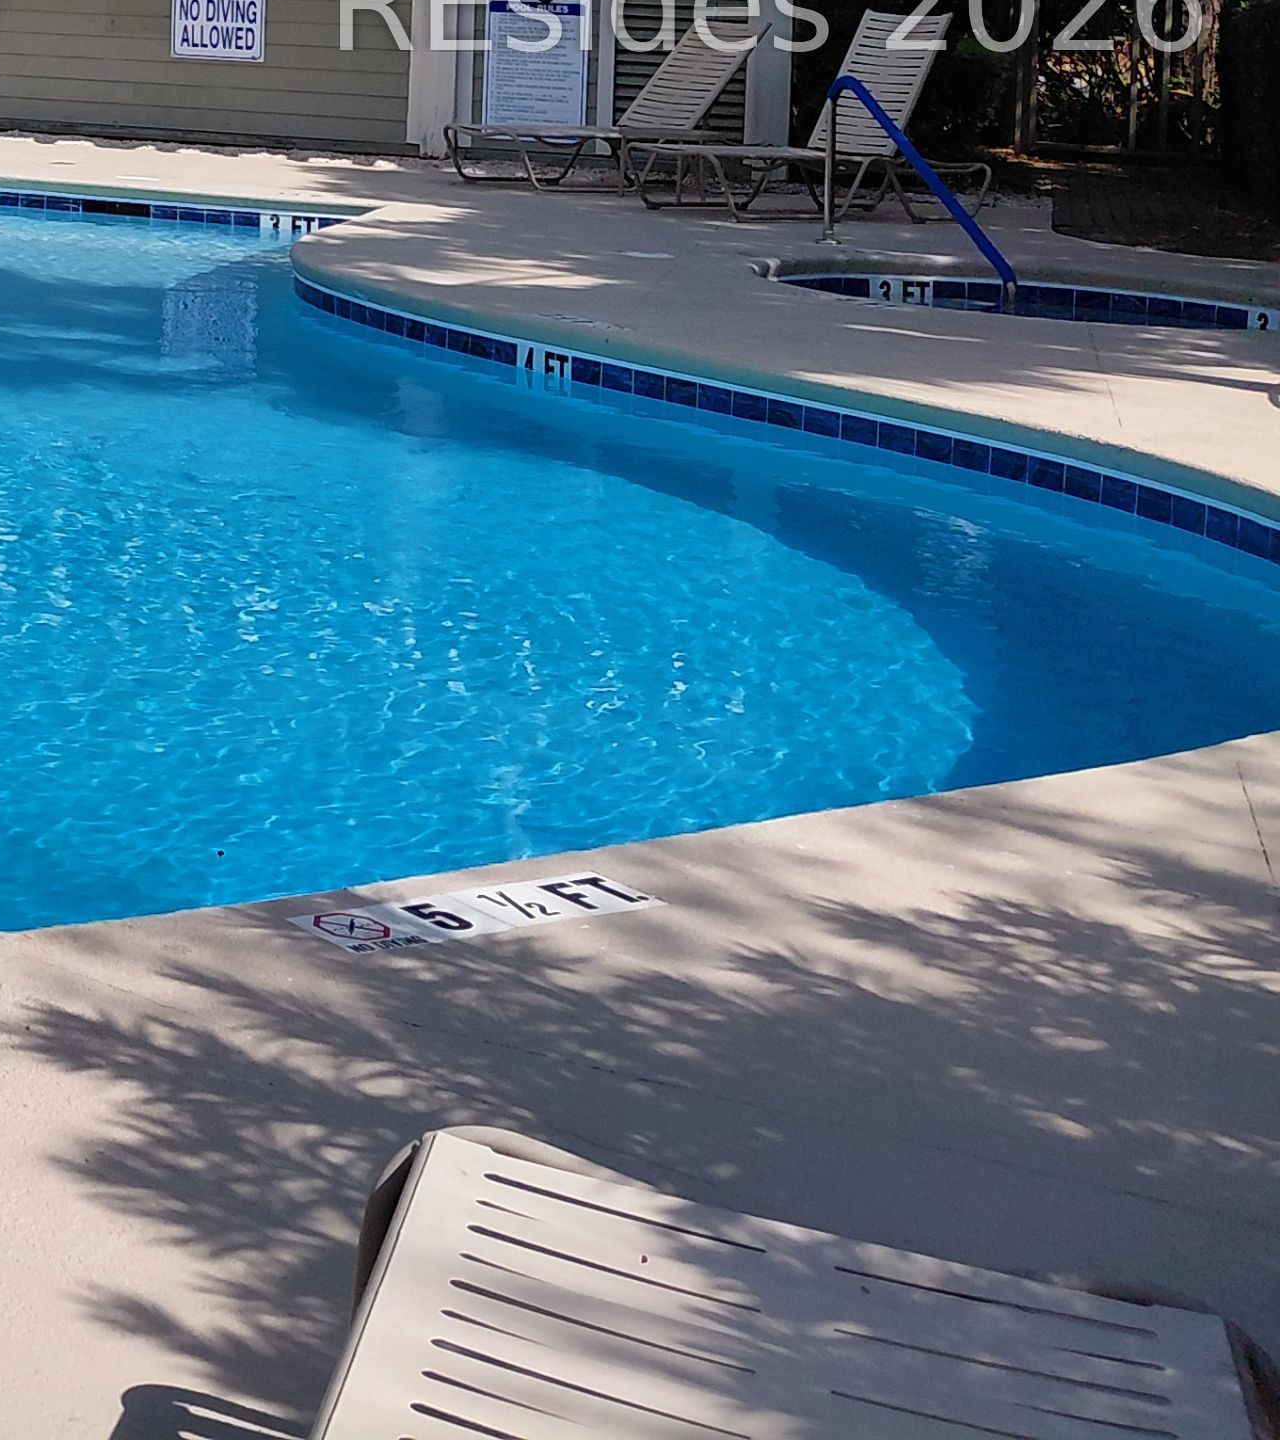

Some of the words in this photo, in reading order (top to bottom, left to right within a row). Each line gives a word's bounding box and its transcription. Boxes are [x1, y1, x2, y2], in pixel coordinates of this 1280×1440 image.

[506, 3, 534, 12] POOL
[537, 4, 569, 14] RULES
[180, 24, 255, 50] ALLOWED
[292, 216, 316, 233] FT
[903, 281, 930, 305] FT
[544, 350, 569, 380] FT
[399, 902, 475, 931] 5
